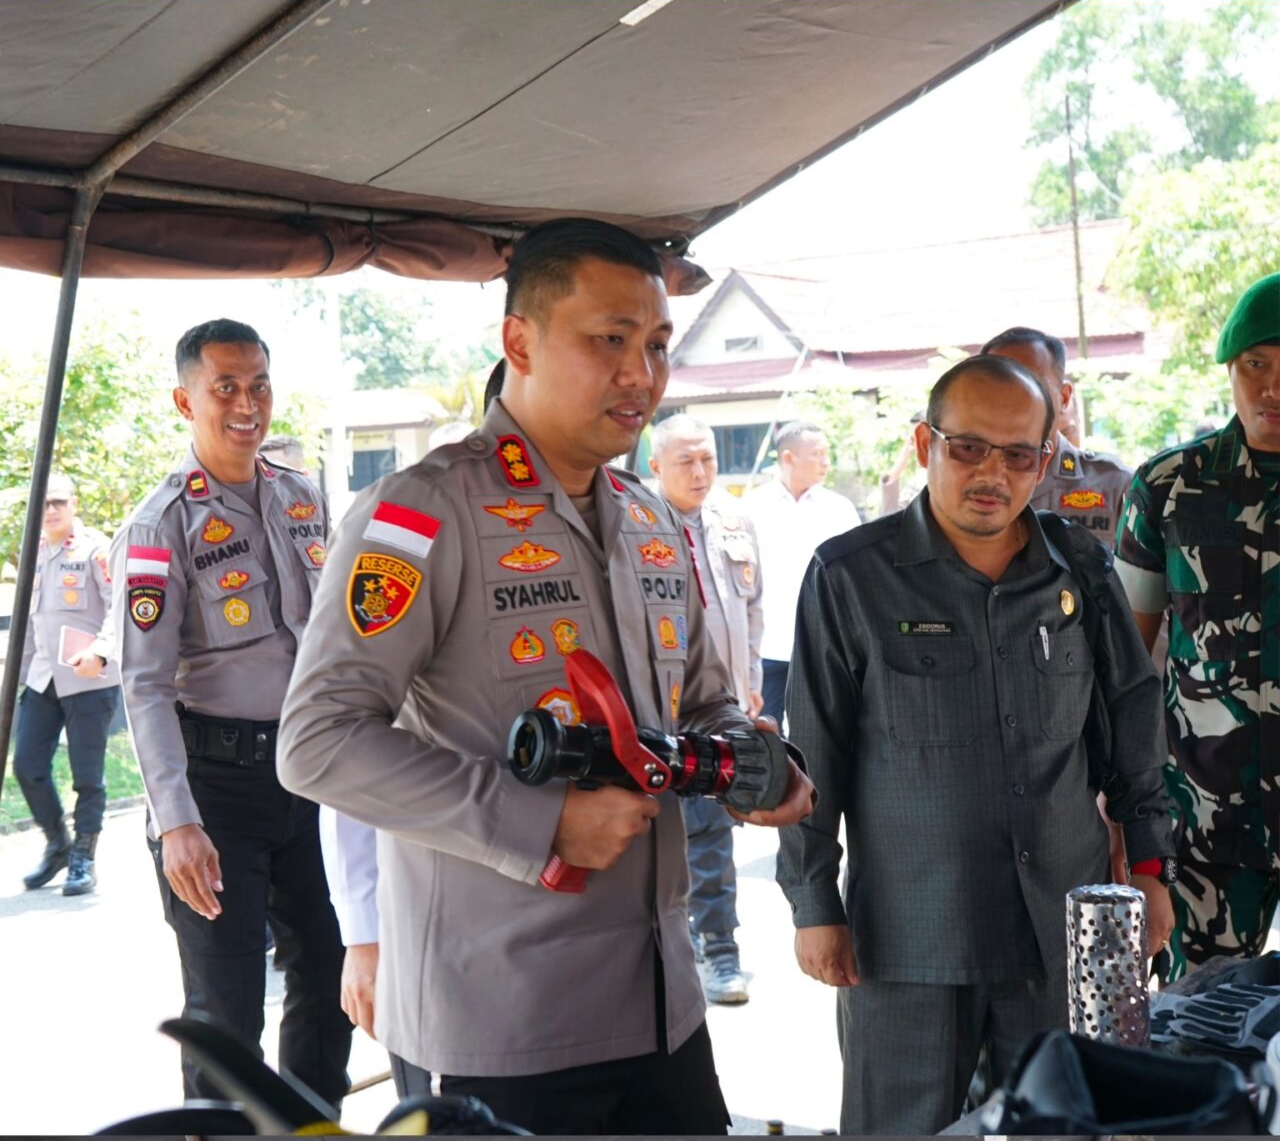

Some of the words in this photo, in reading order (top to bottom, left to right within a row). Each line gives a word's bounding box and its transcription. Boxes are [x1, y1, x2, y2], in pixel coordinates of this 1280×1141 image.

[1068, 515, 1110, 530] OLRI
[60, 563, 85, 571] POLRI
[194, 539, 250, 571] BHANU
[361, 557, 417, 587] RESERSE
[494, 580, 580, 611] SYAHRUL
[641, 577, 685, 600] POLRI
